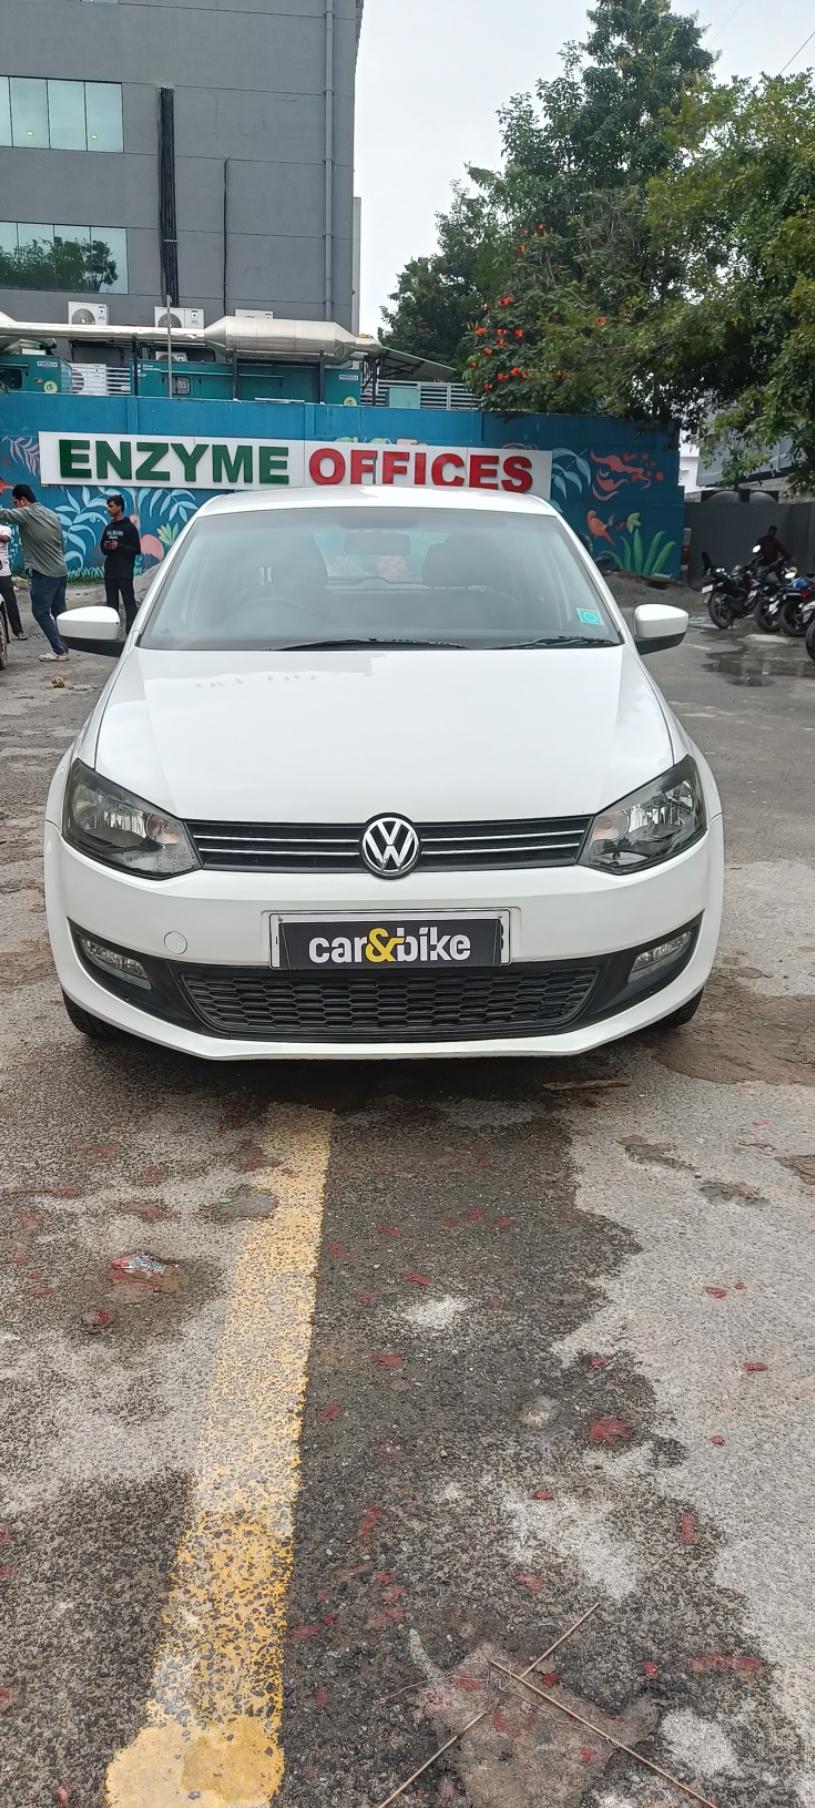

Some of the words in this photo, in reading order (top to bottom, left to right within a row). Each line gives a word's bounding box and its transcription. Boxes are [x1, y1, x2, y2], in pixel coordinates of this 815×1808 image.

[58, 439, 290, 485] ENZYME
[308, 447, 534, 494] OFFICES
[362, 817, 420, 877] VW
